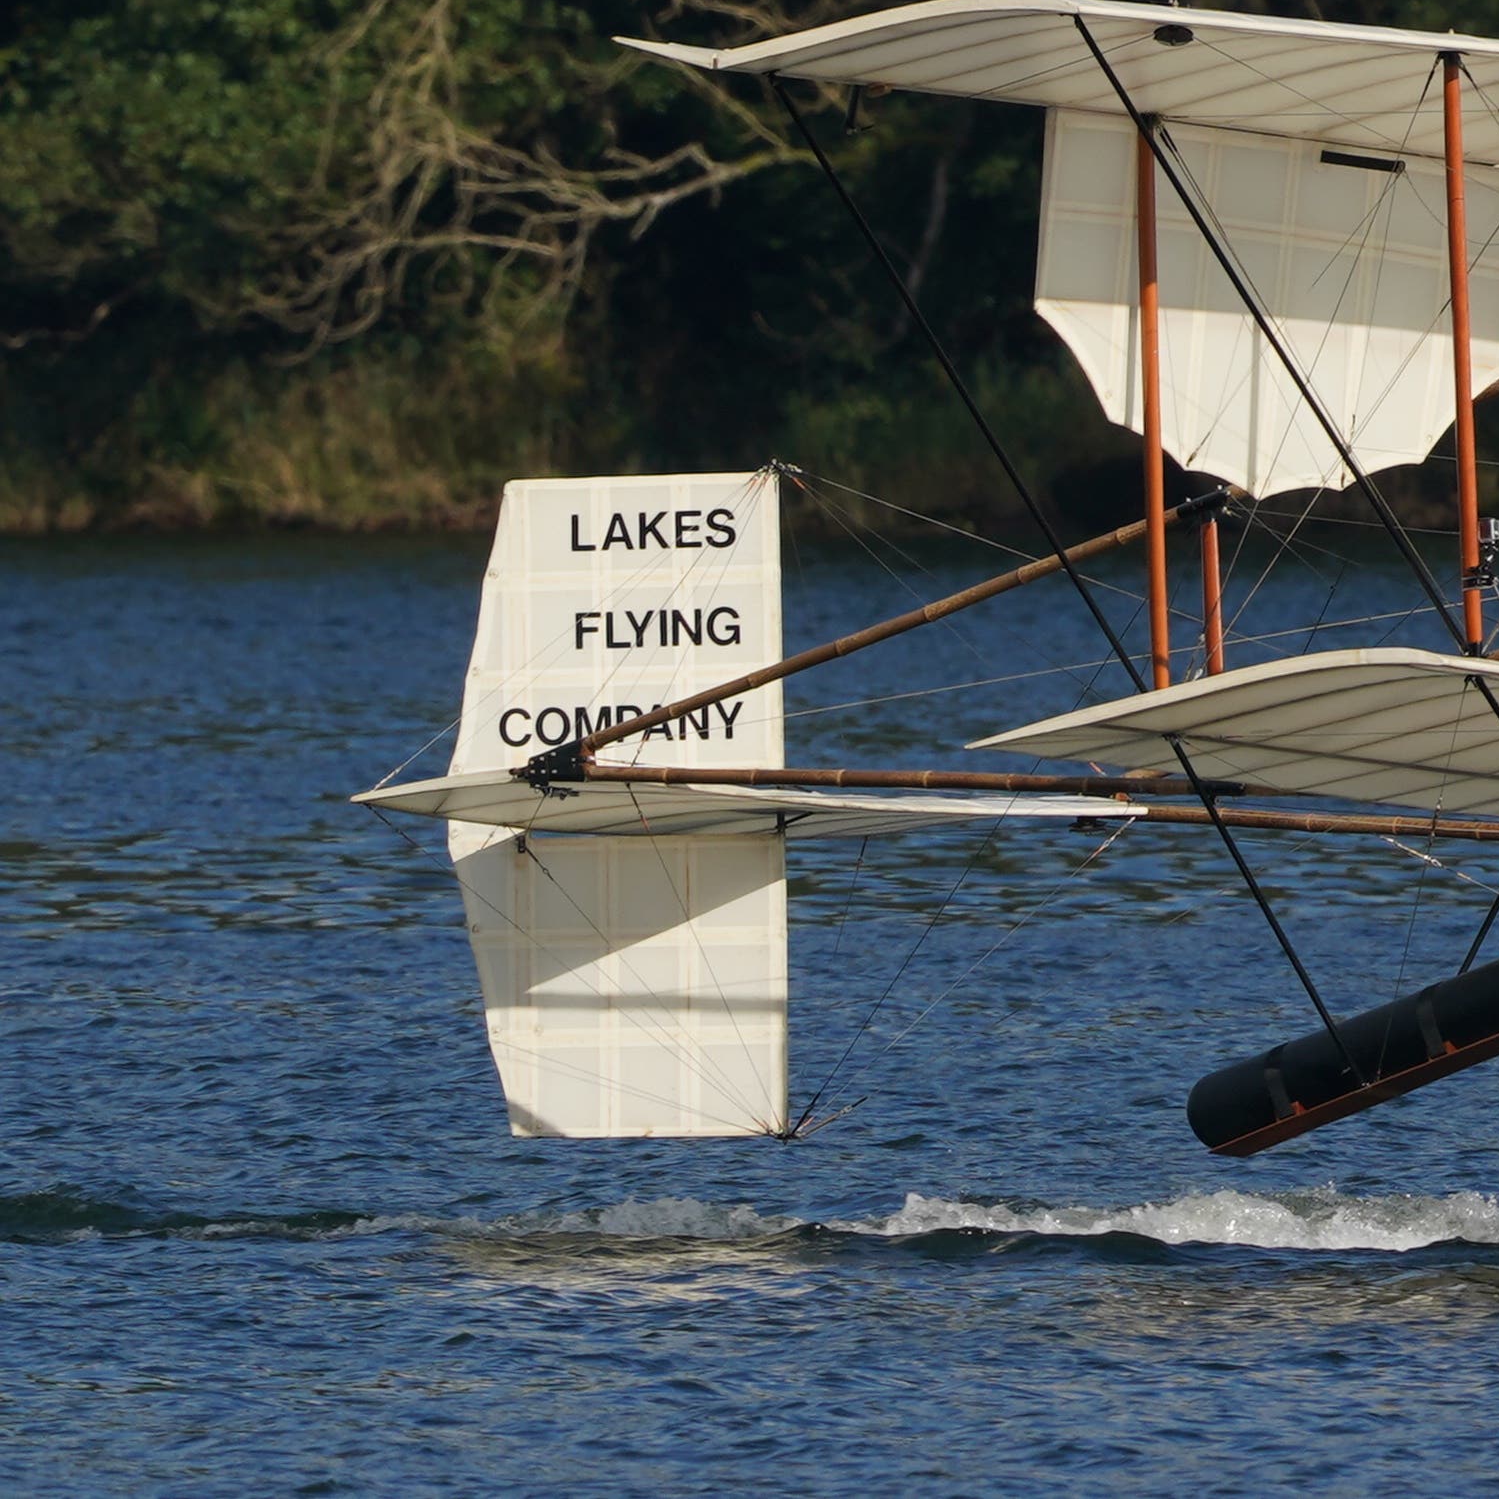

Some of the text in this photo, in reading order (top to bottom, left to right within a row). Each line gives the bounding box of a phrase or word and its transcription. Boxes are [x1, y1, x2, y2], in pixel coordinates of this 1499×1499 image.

[571, 508, 737, 551] LAKES
[575, 606, 741, 650] FLYING
[498, 701, 744, 747] COMPANY
